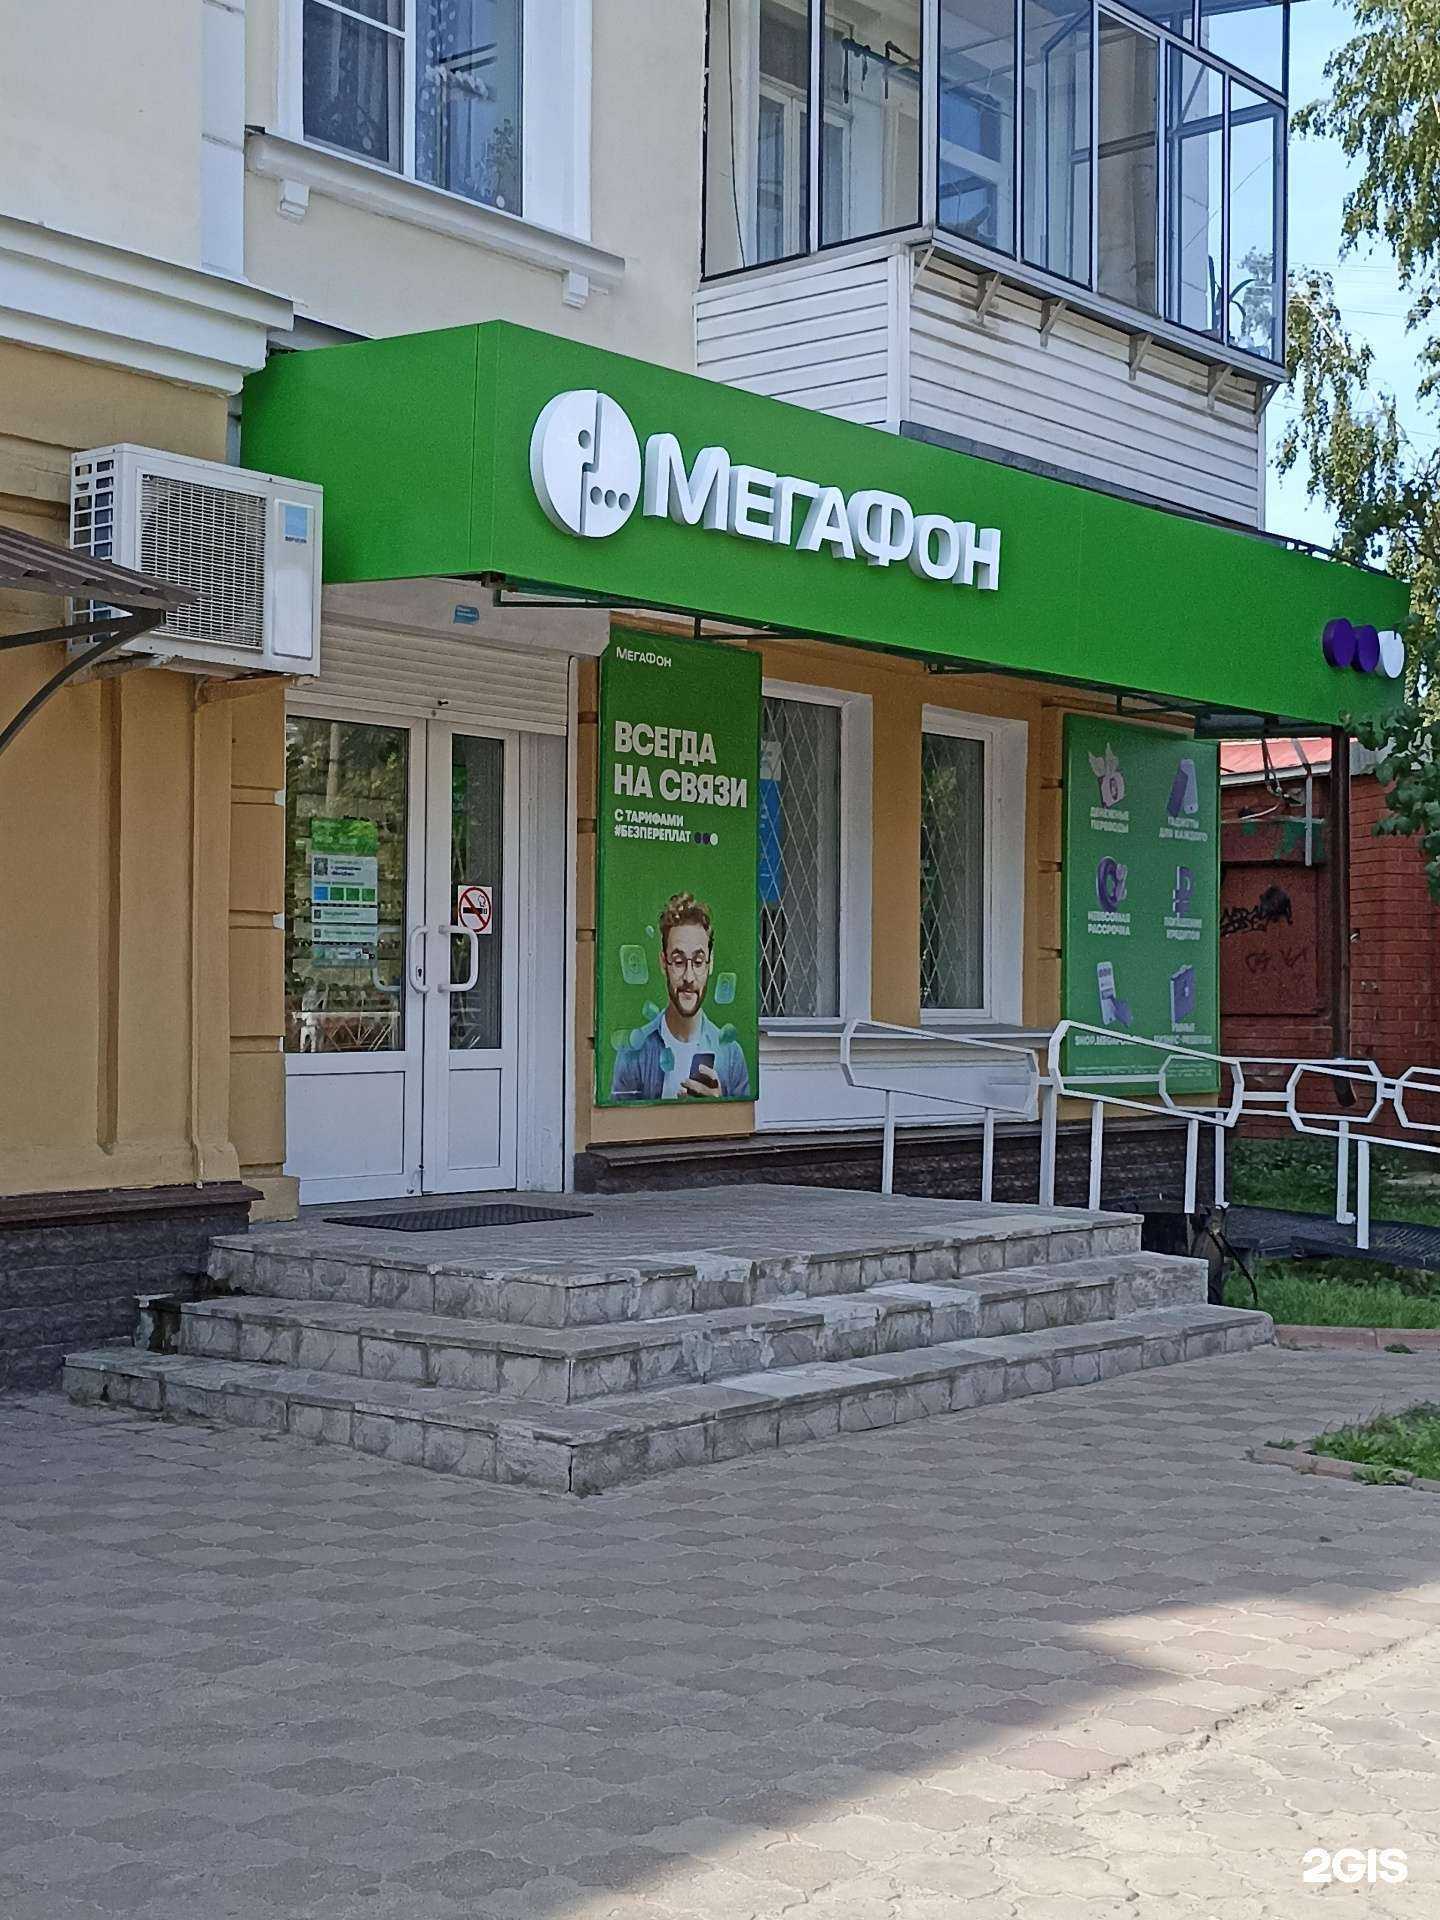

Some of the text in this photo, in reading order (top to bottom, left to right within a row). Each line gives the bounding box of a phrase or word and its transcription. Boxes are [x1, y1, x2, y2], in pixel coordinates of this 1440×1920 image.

[643, 432, 1001, 591] МЕГАФОН
[616, 646, 672, 668] МЕГАФОН
[614, 720, 717, 767] ВСЕГДА
[613, 763, 748, 809] НА СВЯЗИ
[614, 808, 684, 827] С ТАРИФАМИ
[614, 824, 691, 843] #БЕЗПЕРЕПЛАТ
